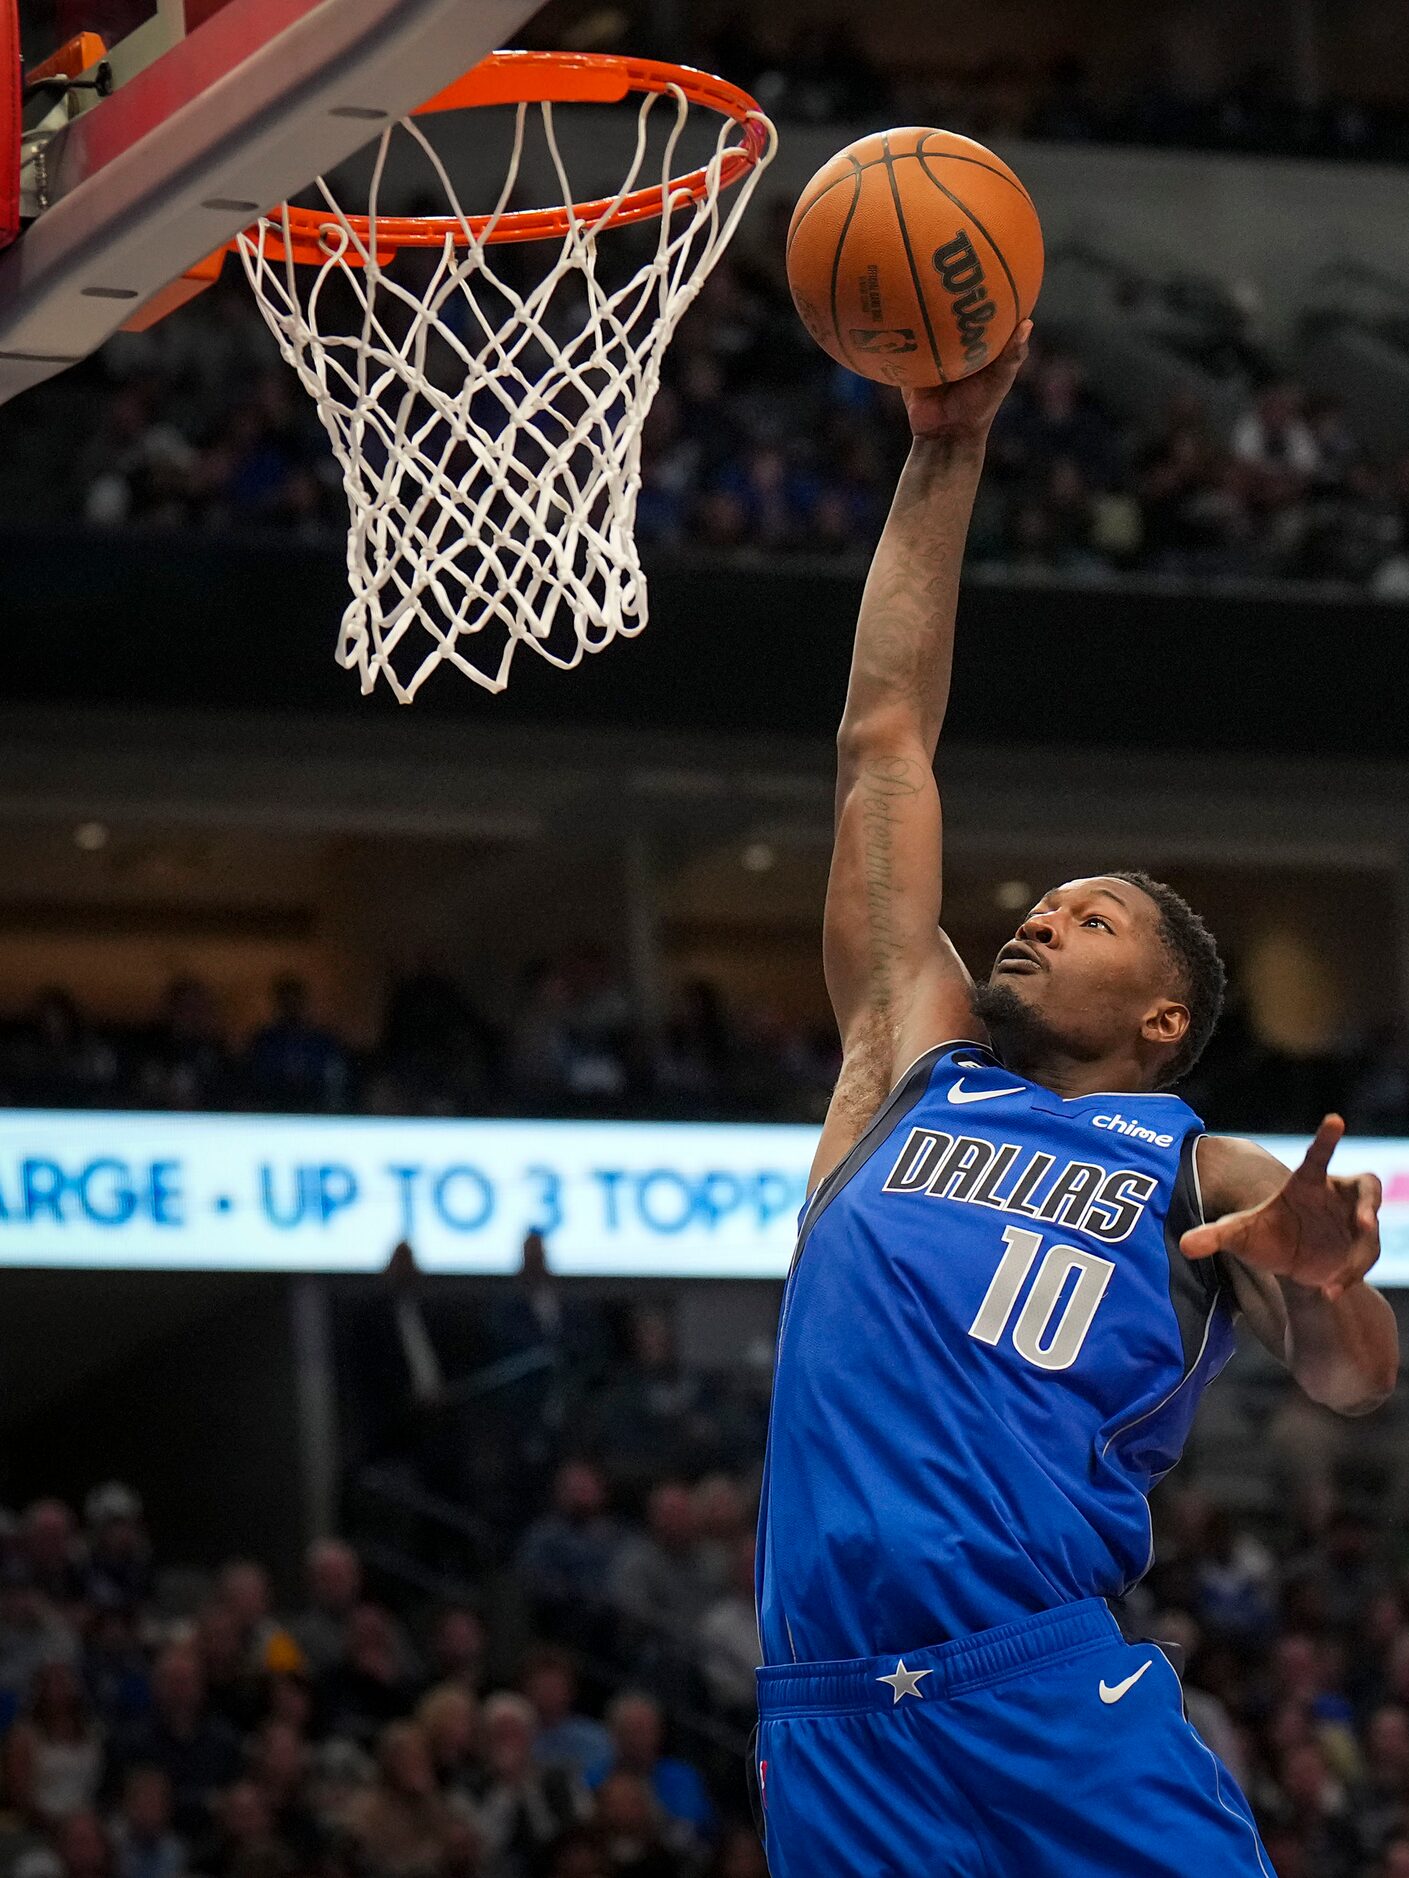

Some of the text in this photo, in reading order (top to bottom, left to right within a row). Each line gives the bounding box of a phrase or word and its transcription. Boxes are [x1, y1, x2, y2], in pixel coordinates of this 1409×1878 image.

[931, 228, 997, 370] Wilso
[881, 1126, 1158, 1243] DALLAS
[1092, 1114, 1174, 1148] chime
[256, 1161, 361, 1230] UP
[386, 1161, 496, 1240] TO
[524, 1163, 563, 1237] 3
[968, 1225, 1116, 1371] 10
